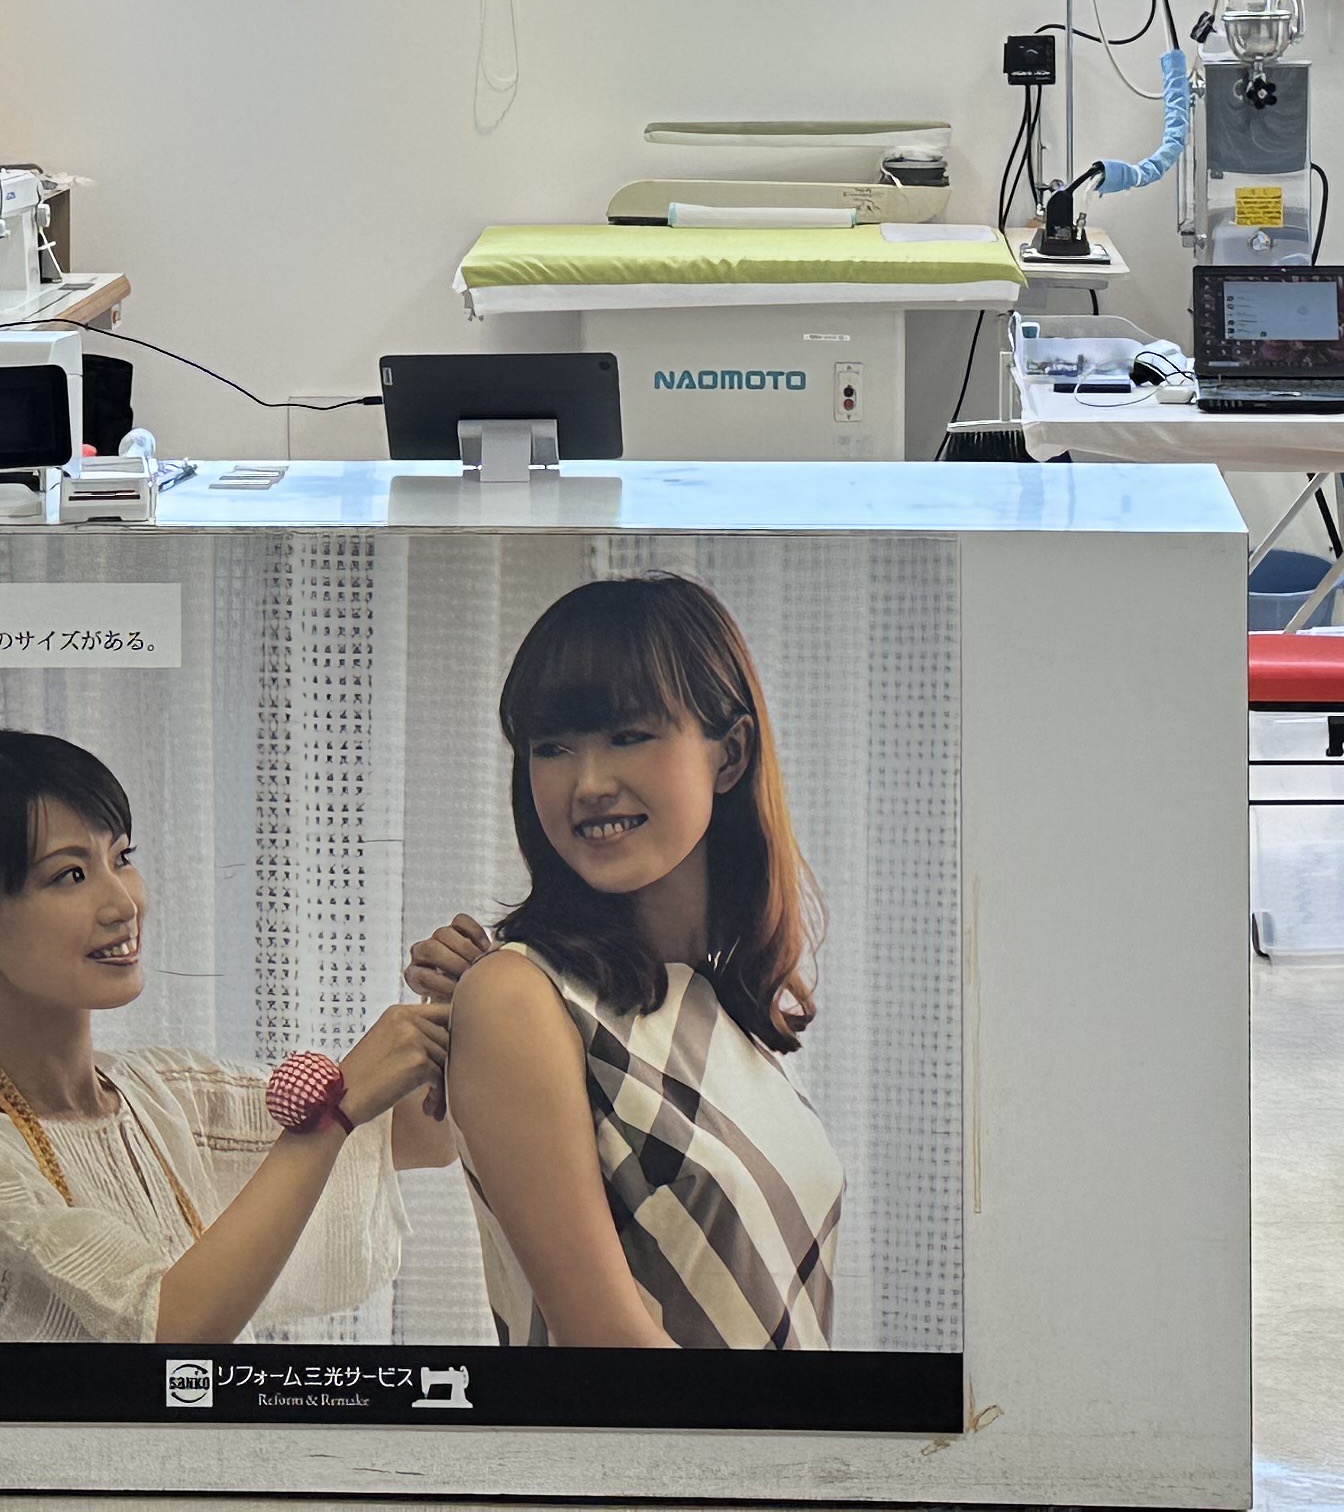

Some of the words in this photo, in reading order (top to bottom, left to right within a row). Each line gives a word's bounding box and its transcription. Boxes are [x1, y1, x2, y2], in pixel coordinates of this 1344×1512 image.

[654, 370, 806, 391] NAOMOTO
[218, 1365, 413, 1388] リフォーム三光サービス
[258, 1392, 304, 1406] Reform
[305, 1395, 318, 1406] &
